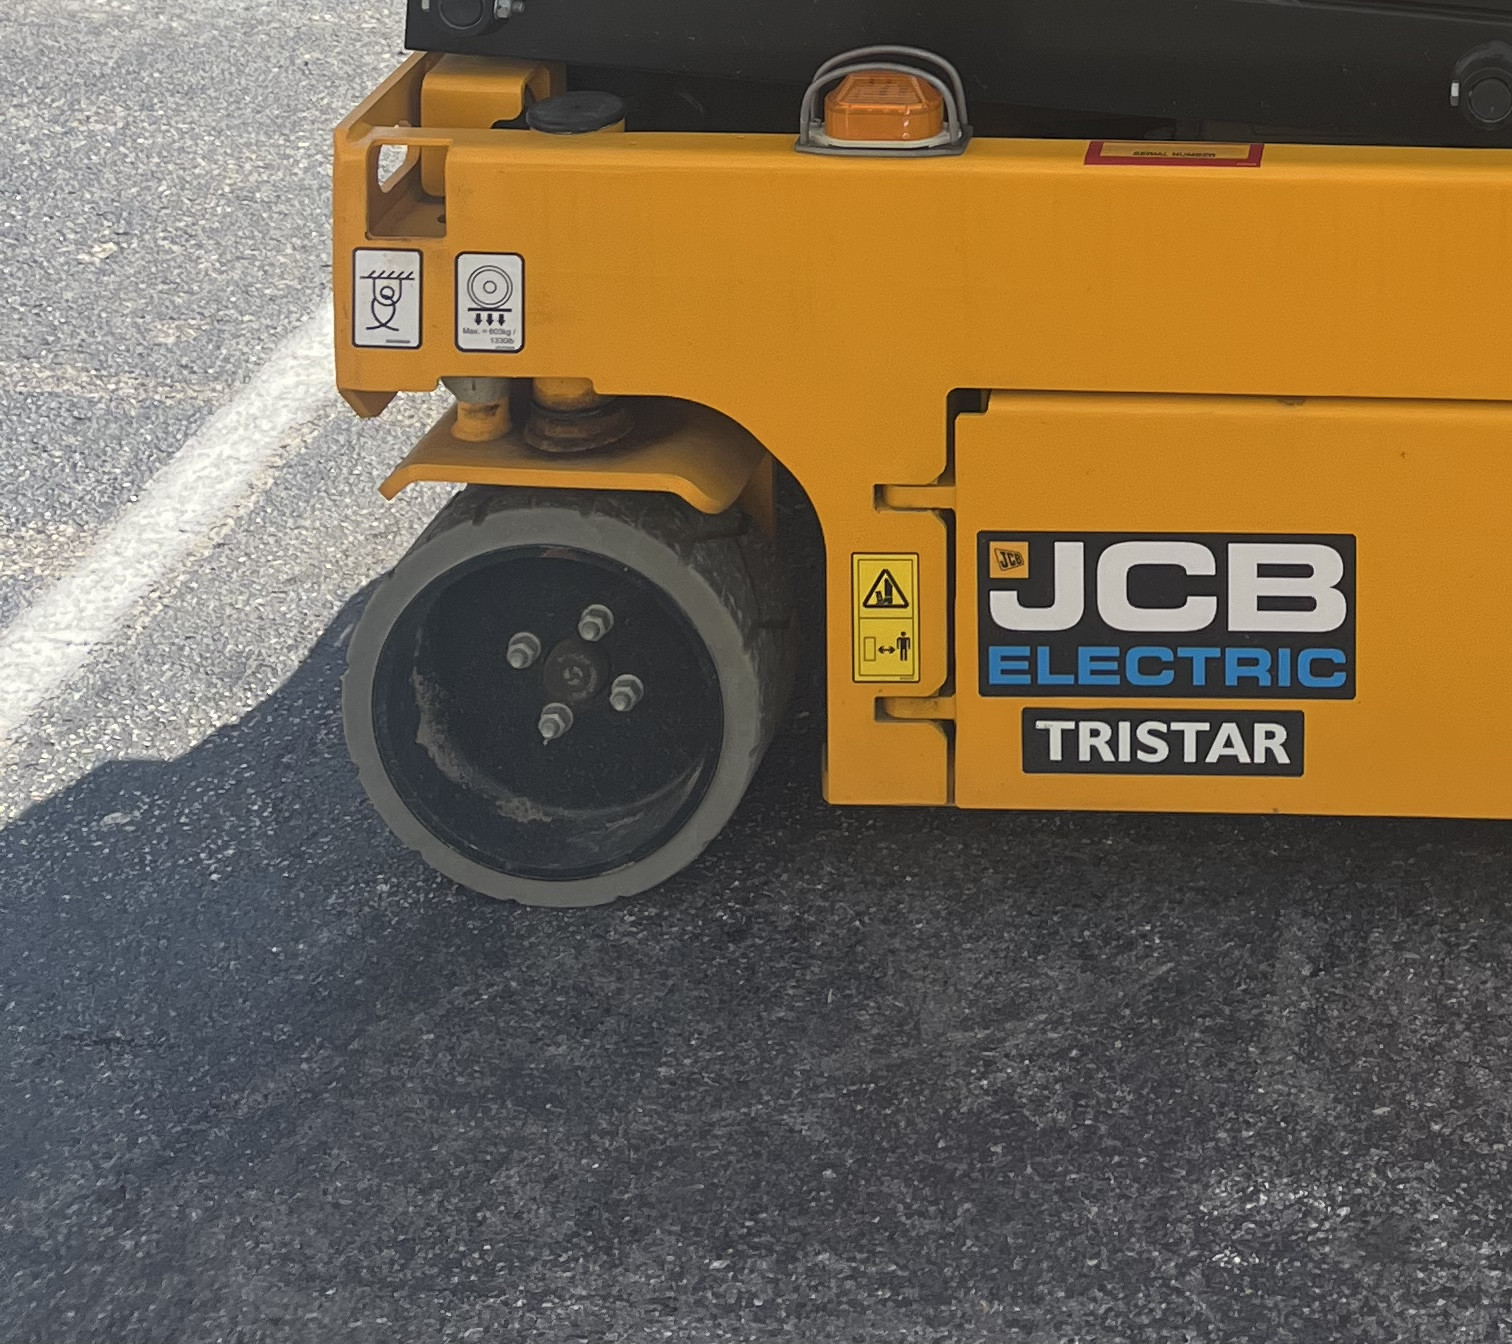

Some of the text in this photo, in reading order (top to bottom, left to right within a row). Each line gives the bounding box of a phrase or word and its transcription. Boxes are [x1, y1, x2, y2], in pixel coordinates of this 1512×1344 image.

[999, 551, 1022, 568] JCB
[989, 541, 1347, 633] JCB
[988, 645, 1347, 688] ELECTRIC
[1035, 720, 1291, 764] TRISTAR
